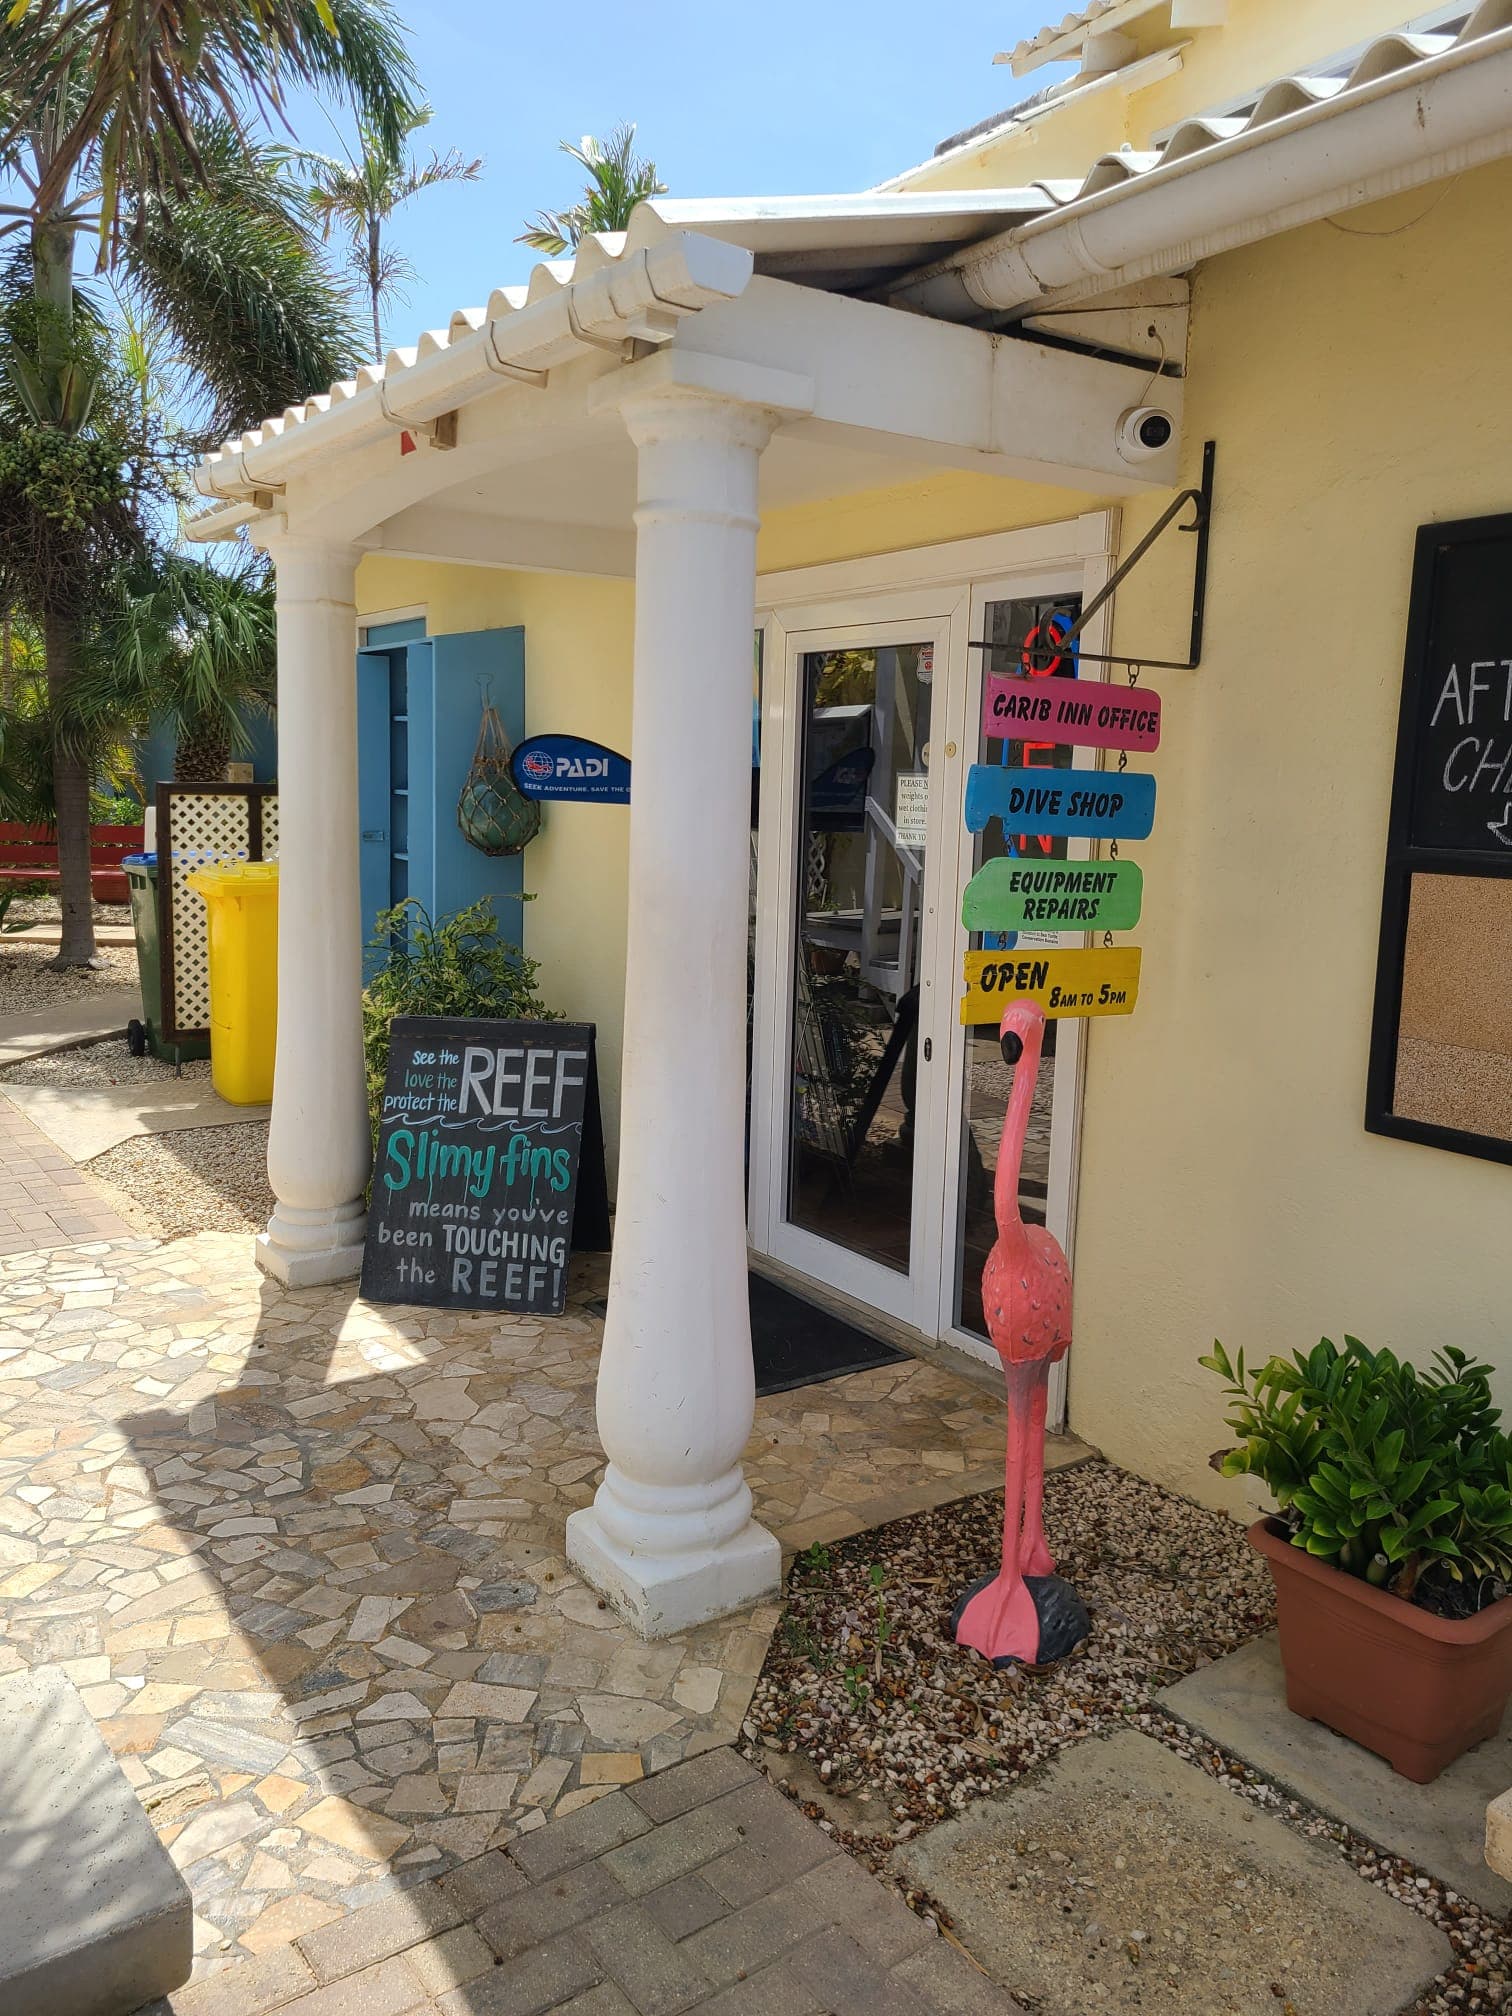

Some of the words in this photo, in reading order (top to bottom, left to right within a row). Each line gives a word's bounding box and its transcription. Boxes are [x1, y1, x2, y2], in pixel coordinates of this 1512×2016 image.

[992, 694, 1050, 722] CARIB
[1057, 700, 1093, 727] INN
[1097, 704, 1159, 734] OFFICE
[556, 757, 609, 778] PADI
[523, 782, 542, 791] SEEK
[901, 779, 923, 788] PLEASE
[901, 791, 924, 802] weights
[1009, 786, 1063, 816] DIVE
[1067, 790, 1124, 818] SHOP
[903, 815, 910, 824] in
[910, 817, 927, 825] store.
[898, 832, 917, 841] THANK
[1010, 872, 1117, 894] EQUIPMENT
[1023, 898, 1099, 921] REPAIRS
[979, 961, 1050, 993] OPEN
[1049, 986, 1078, 1009] 8AM
[1081, 993, 1094, 1006] TO
[1098, 983, 1127, 1005] 5PM
[412, 1050, 437, 1066] see
[439, 1049, 460, 1066] the
[404, 1069, 434, 1089] love
[437, 1069, 457, 1089] the
[458, 1046, 588, 1118] REEF
[383, 1094, 435, 1113] protect
[437, 1093, 458, 1112] the
[383, 1129, 496, 1199] Slimy
[500, 1133, 571, 1193] fins
[408, 1200, 481, 1220] means
[493, 1198, 569, 1226] you've
[377, 1222, 433, 1247] been
[442, 1223, 566, 1268] TOUCHING
[396, 1257, 436, 1285] the
[452, 1258, 563, 1308] REEF!
